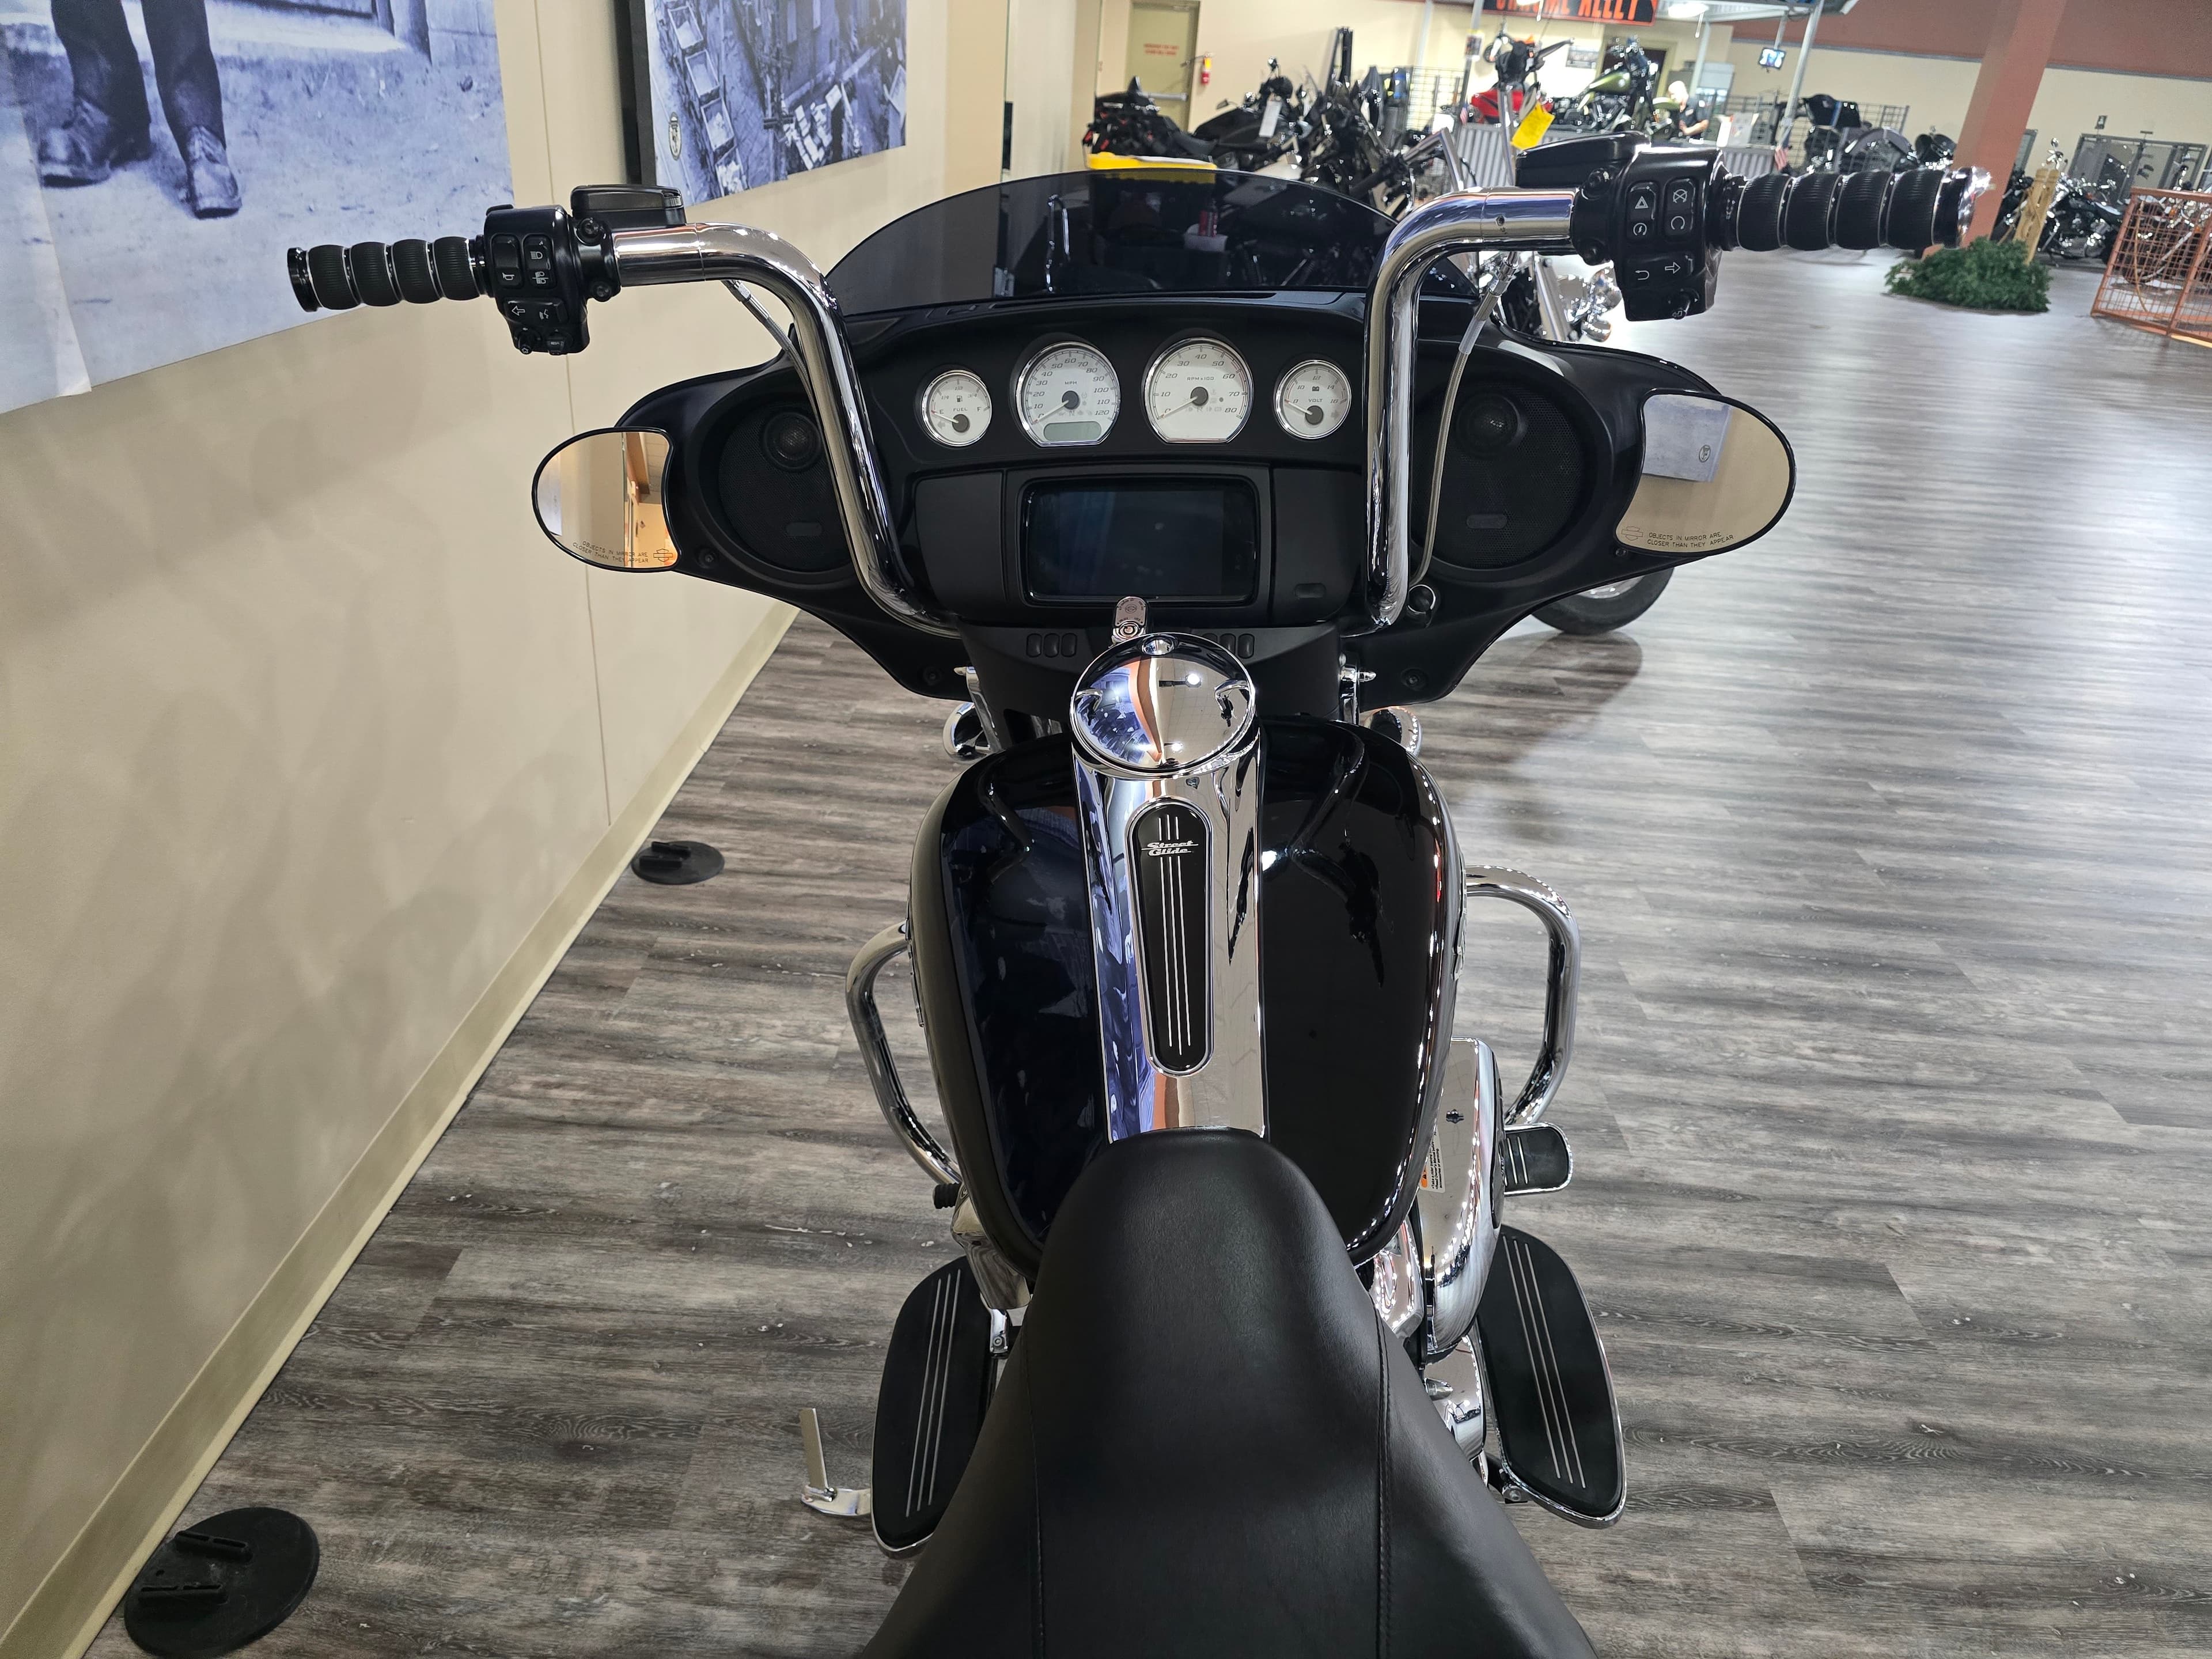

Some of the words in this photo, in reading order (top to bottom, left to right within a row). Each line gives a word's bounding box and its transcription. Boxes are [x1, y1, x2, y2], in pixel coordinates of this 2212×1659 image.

[1649, 532, 1673, 540] OBJECTS
[1710, 532, 1721, 540] ARE
[1710, 535, 1734, 546] APPEAR
[573, 542, 592, 554] CLOSER
[595, 552, 609, 560] THAN
[582, 541, 605, 553] OBJECTS
[1146, 840, 1195, 849] Street
[1148, 847, 1192, 856] Glide
